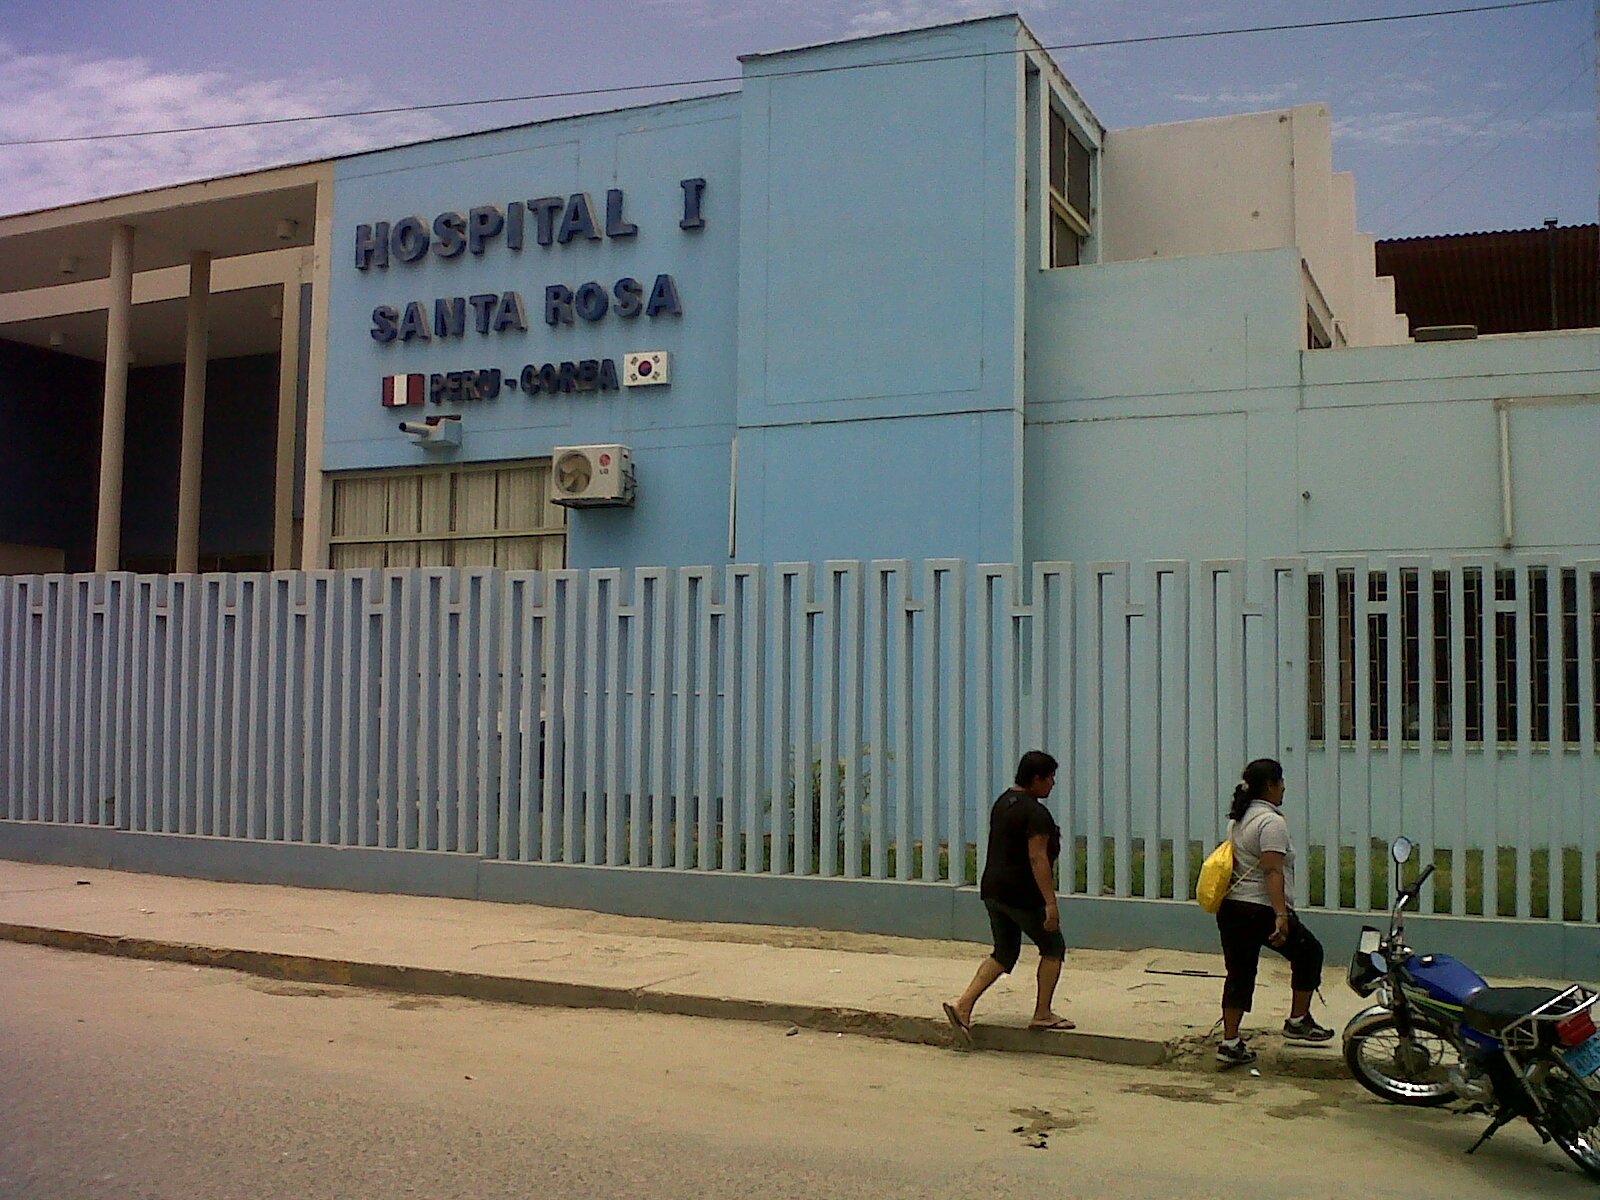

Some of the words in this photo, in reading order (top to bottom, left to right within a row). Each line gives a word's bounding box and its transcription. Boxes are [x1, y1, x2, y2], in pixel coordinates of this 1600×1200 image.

[354, 188, 639, 271] HOSPITAL
[679, 177, 707, 231] I
[370, 291, 528, 343] SANTA
[544, 273, 682, 326] ROSA
